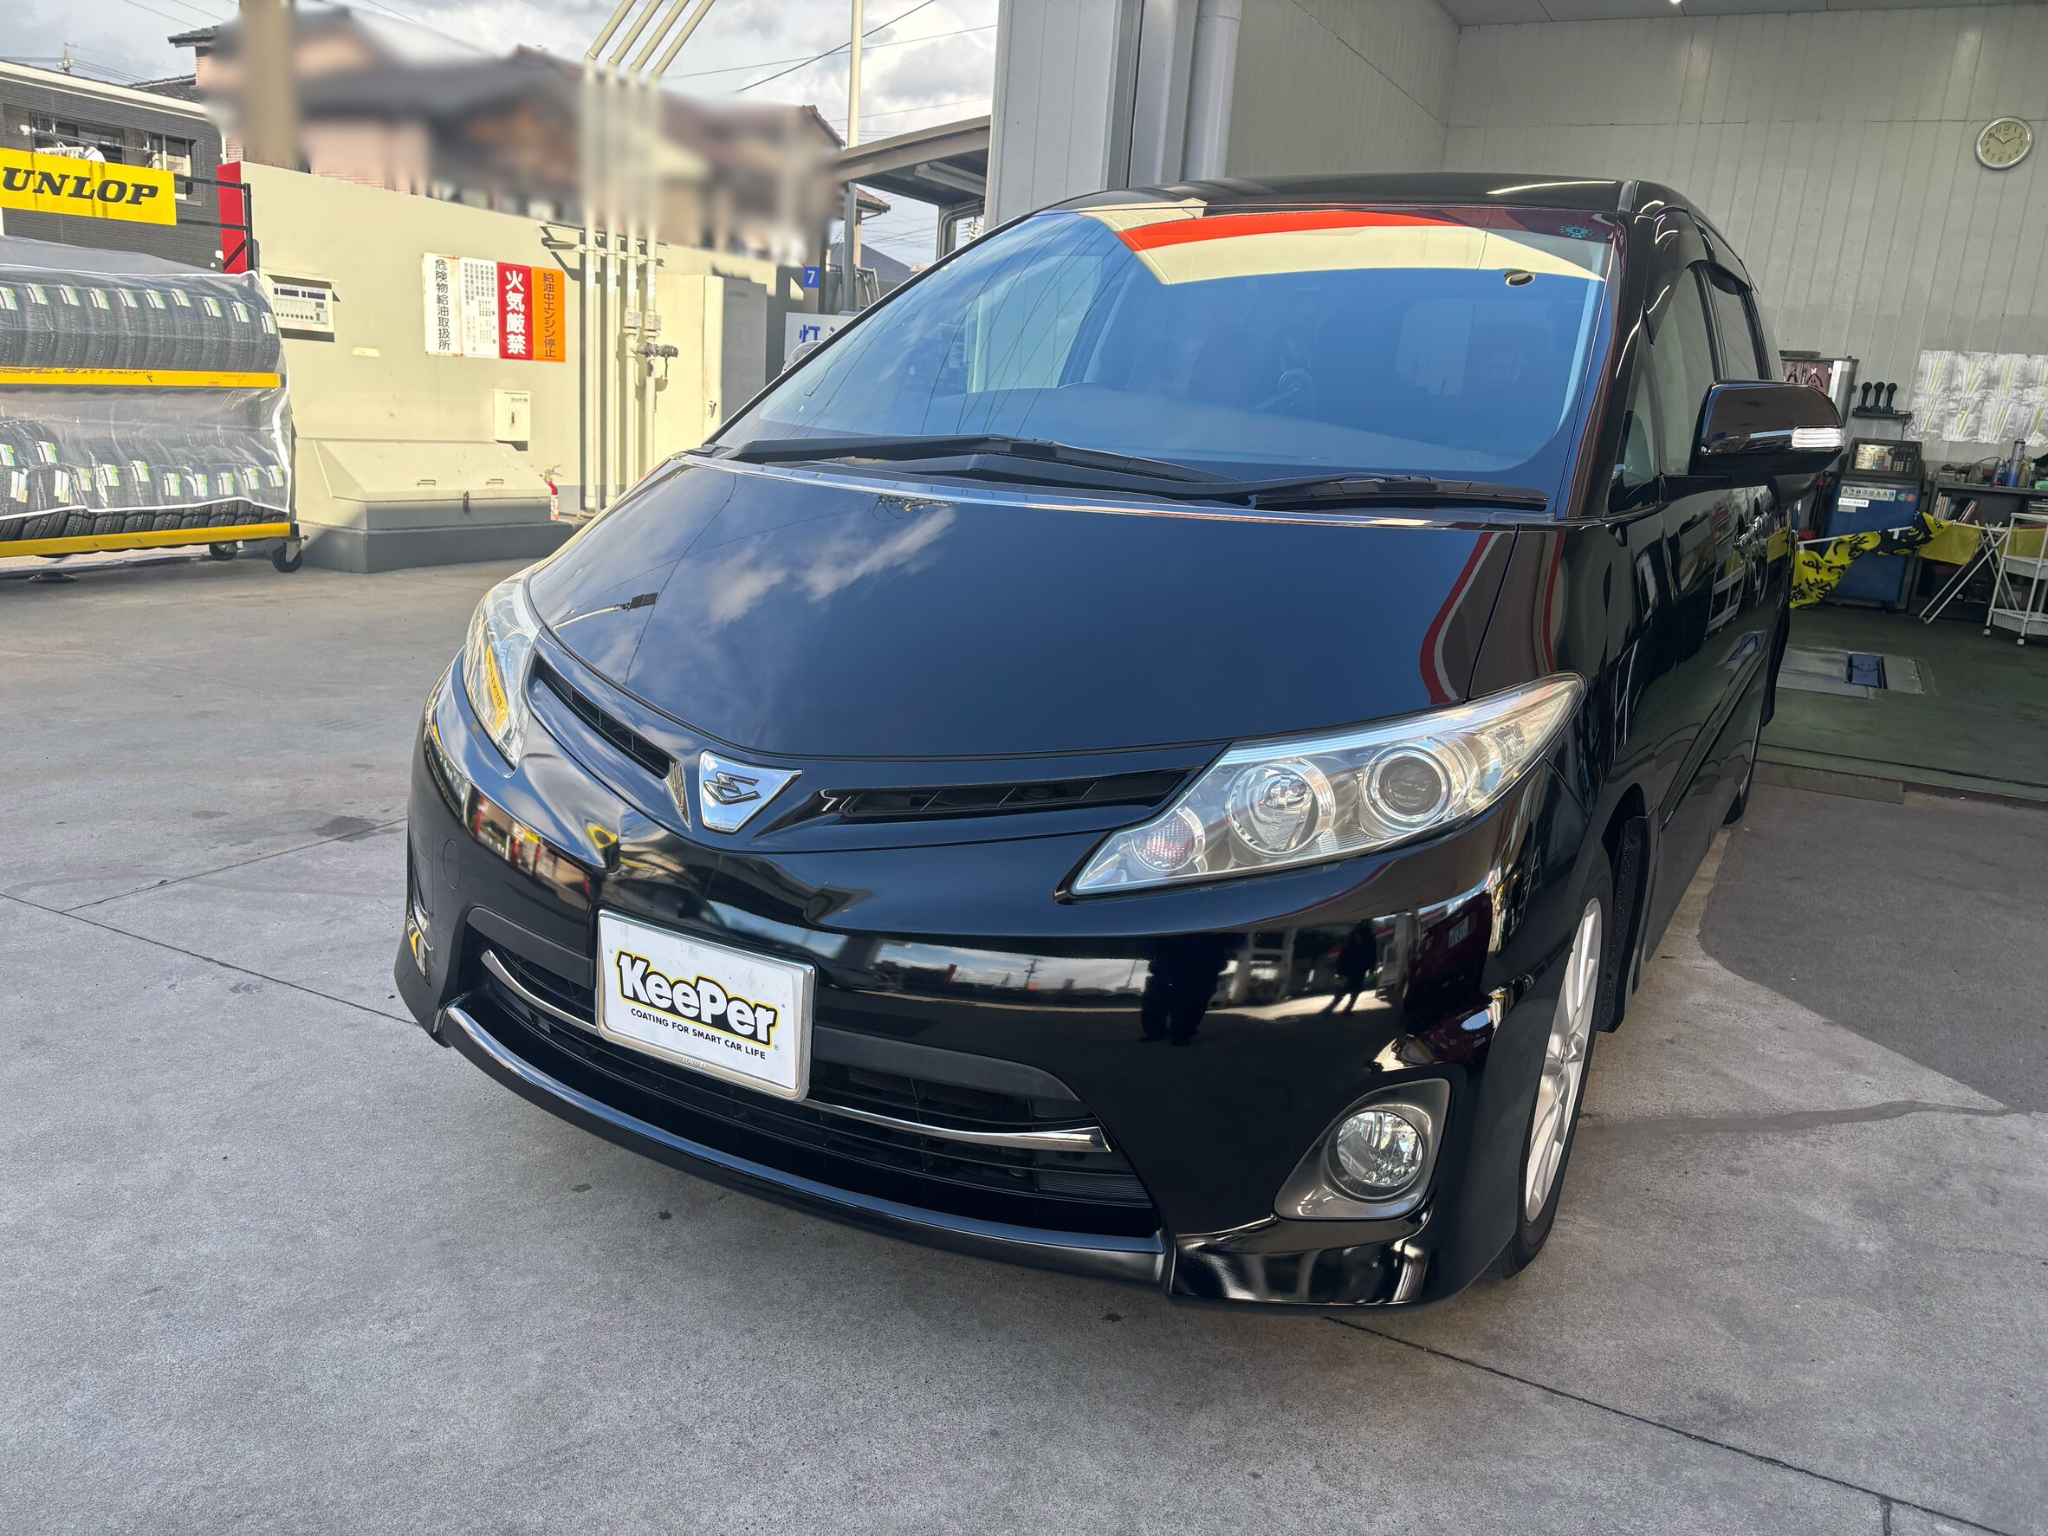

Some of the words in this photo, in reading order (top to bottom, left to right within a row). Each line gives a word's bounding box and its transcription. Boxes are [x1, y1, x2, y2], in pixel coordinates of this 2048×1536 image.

[2, 167, 159, 205] UNLOP
[435, 259, 450, 351] 危険物給油取扱所
[505, 269, 526, 355] 火気厳禁
[543, 273, 556, 358] 給油中エンジン停止
[807, 270, 816, 285] 7
[616, 950, 779, 1047] KeePer
[630, 1008, 669, 1028] COATING
[672, 1021, 690, 1035] FOR
[692, 1028, 722, 1046] SMART
[724, 1039, 743, 1053] CAR
[745, 1048, 766, 1060] LIFE
